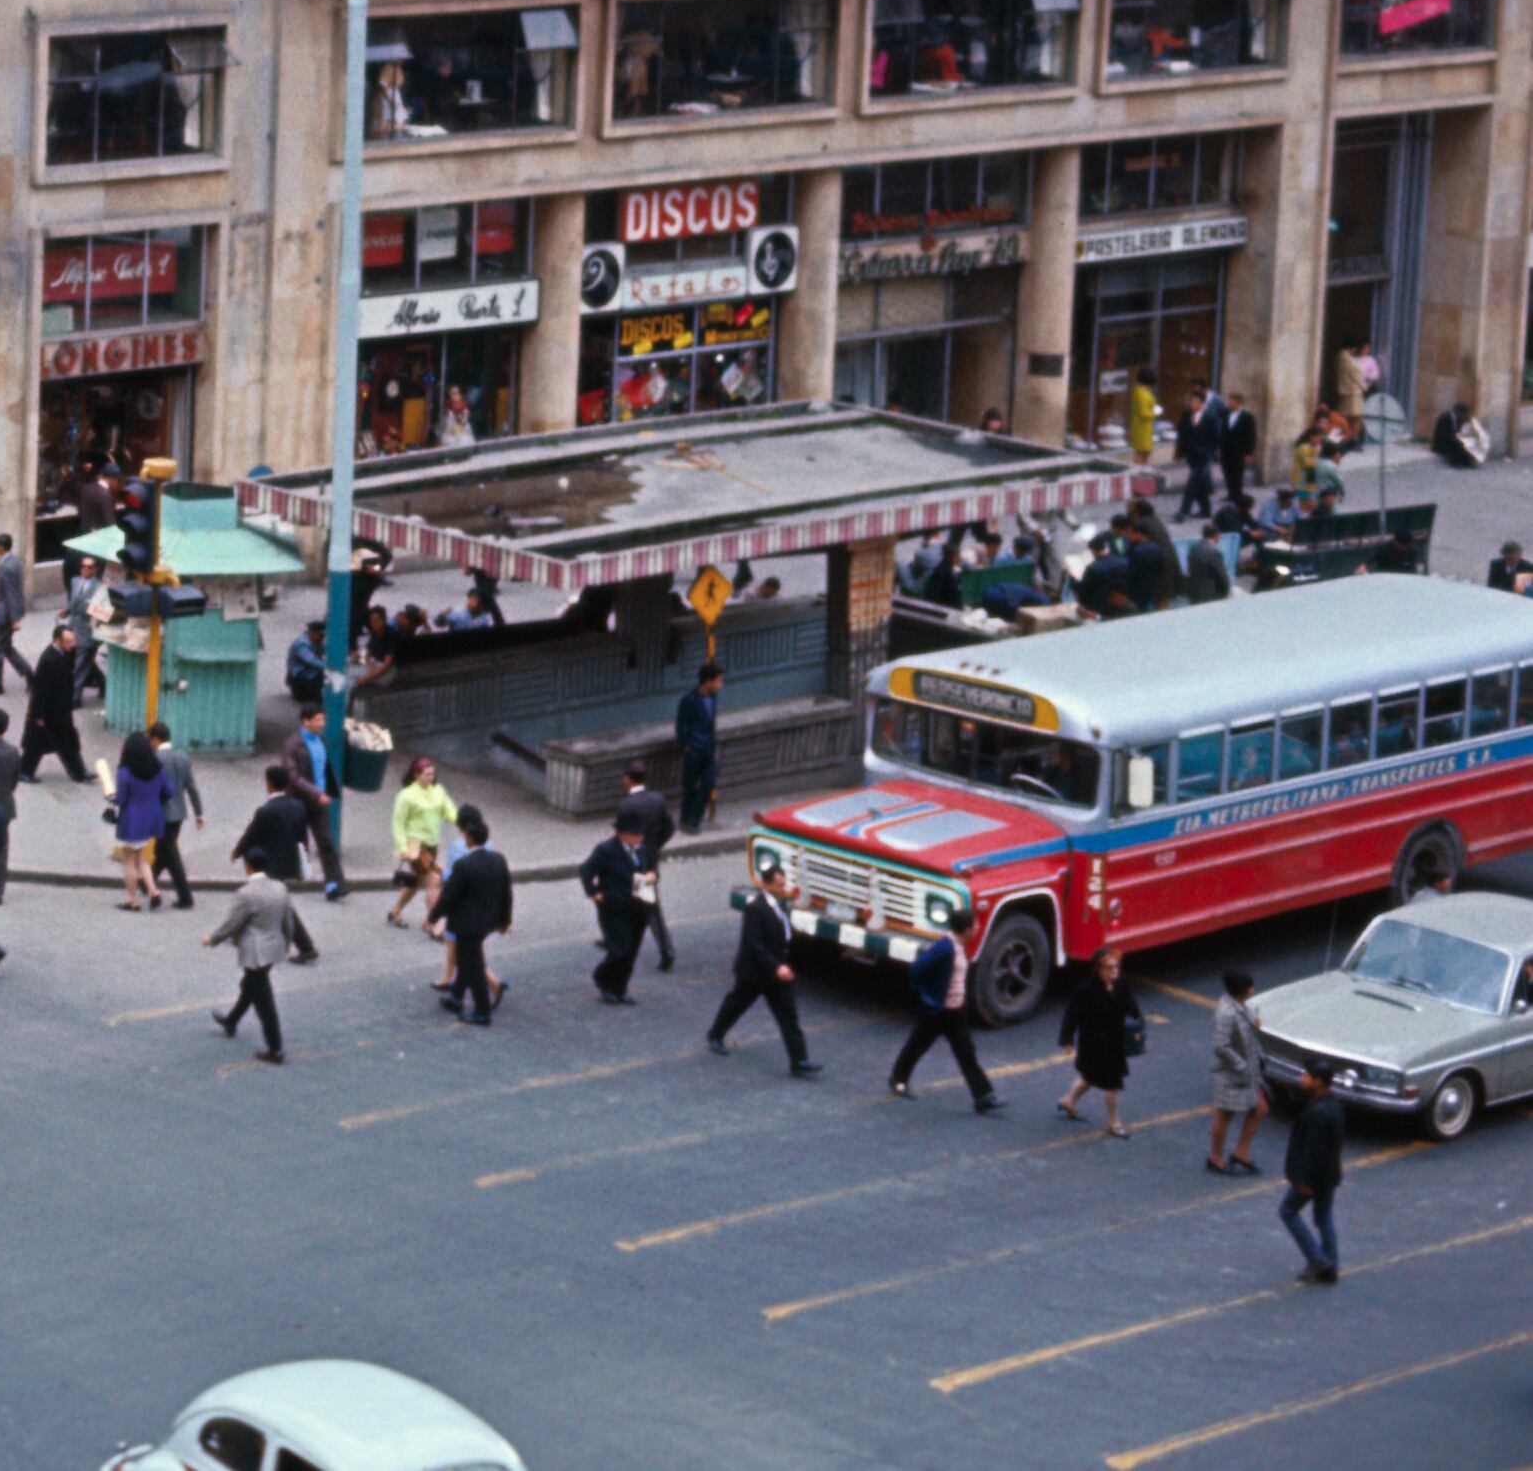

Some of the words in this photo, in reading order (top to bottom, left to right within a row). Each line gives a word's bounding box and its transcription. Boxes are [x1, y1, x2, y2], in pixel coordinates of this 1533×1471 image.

[625, 182, 757, 242] DISCOS
[1086, 229, 1173, 258] PASTELERIA
[1181, 219, 1248, 245] ALEMANA
[620, 314, 685, 346] DISCOS
[41, 330, 199, 377] LONGINES
